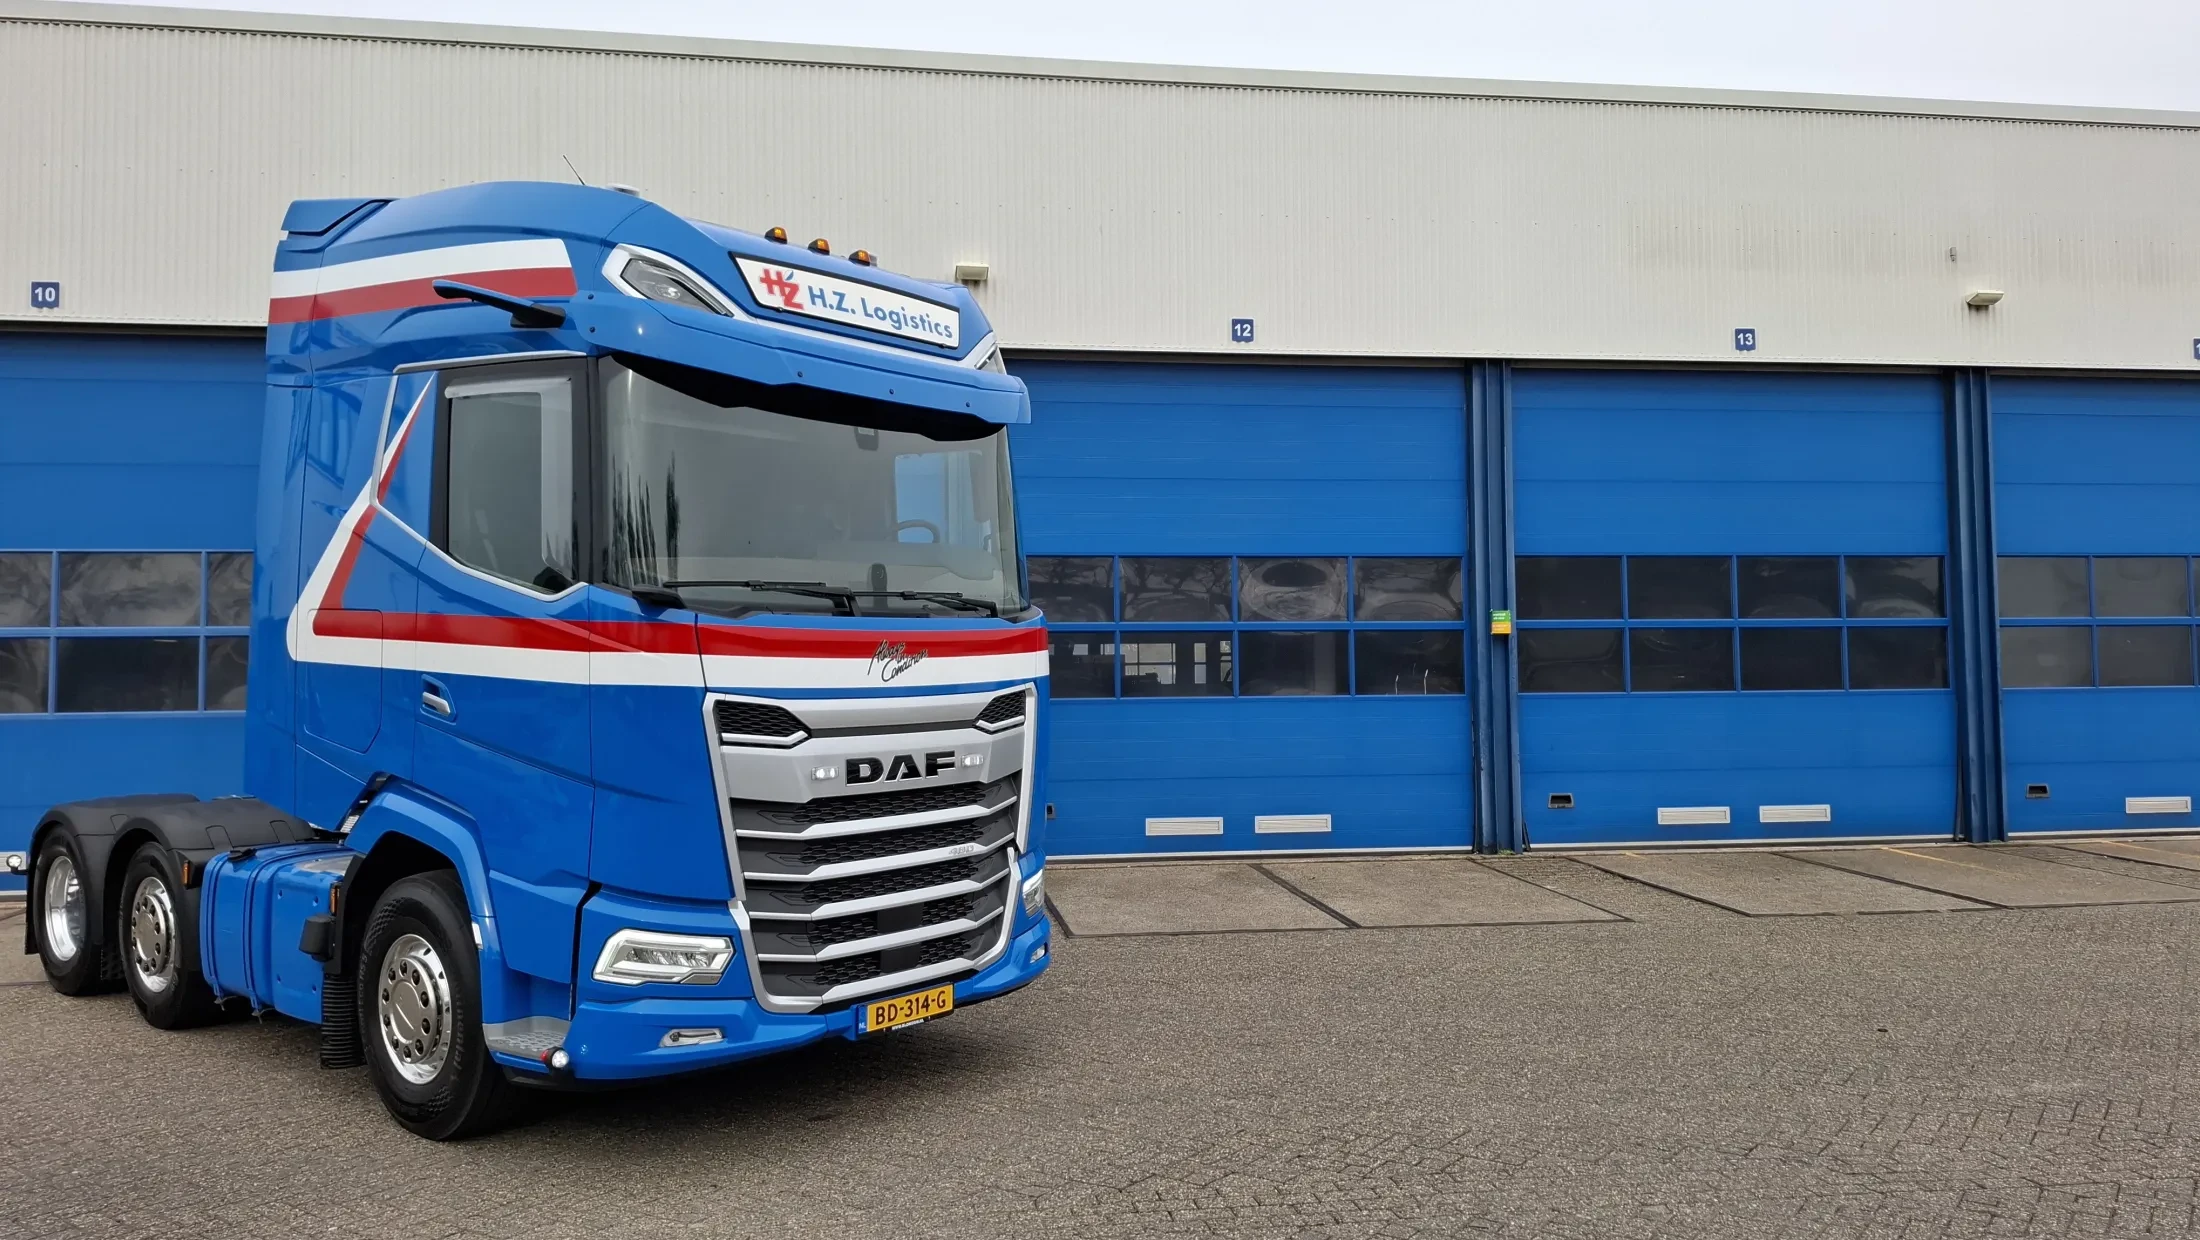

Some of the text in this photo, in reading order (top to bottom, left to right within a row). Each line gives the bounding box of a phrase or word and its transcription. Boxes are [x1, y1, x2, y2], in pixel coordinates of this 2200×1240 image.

[34, 286, 56, 302] 10
[807, 285, 953, 339] H.Z. Logistics
[1234, 323, 1252, 337] 12
[1737, 332, 1754, 346] 13
[846, 750, 956, 786] DAF
[875, 990, 946, 1026] BD-314-G
[859, 1022, 866, 1030] NL
